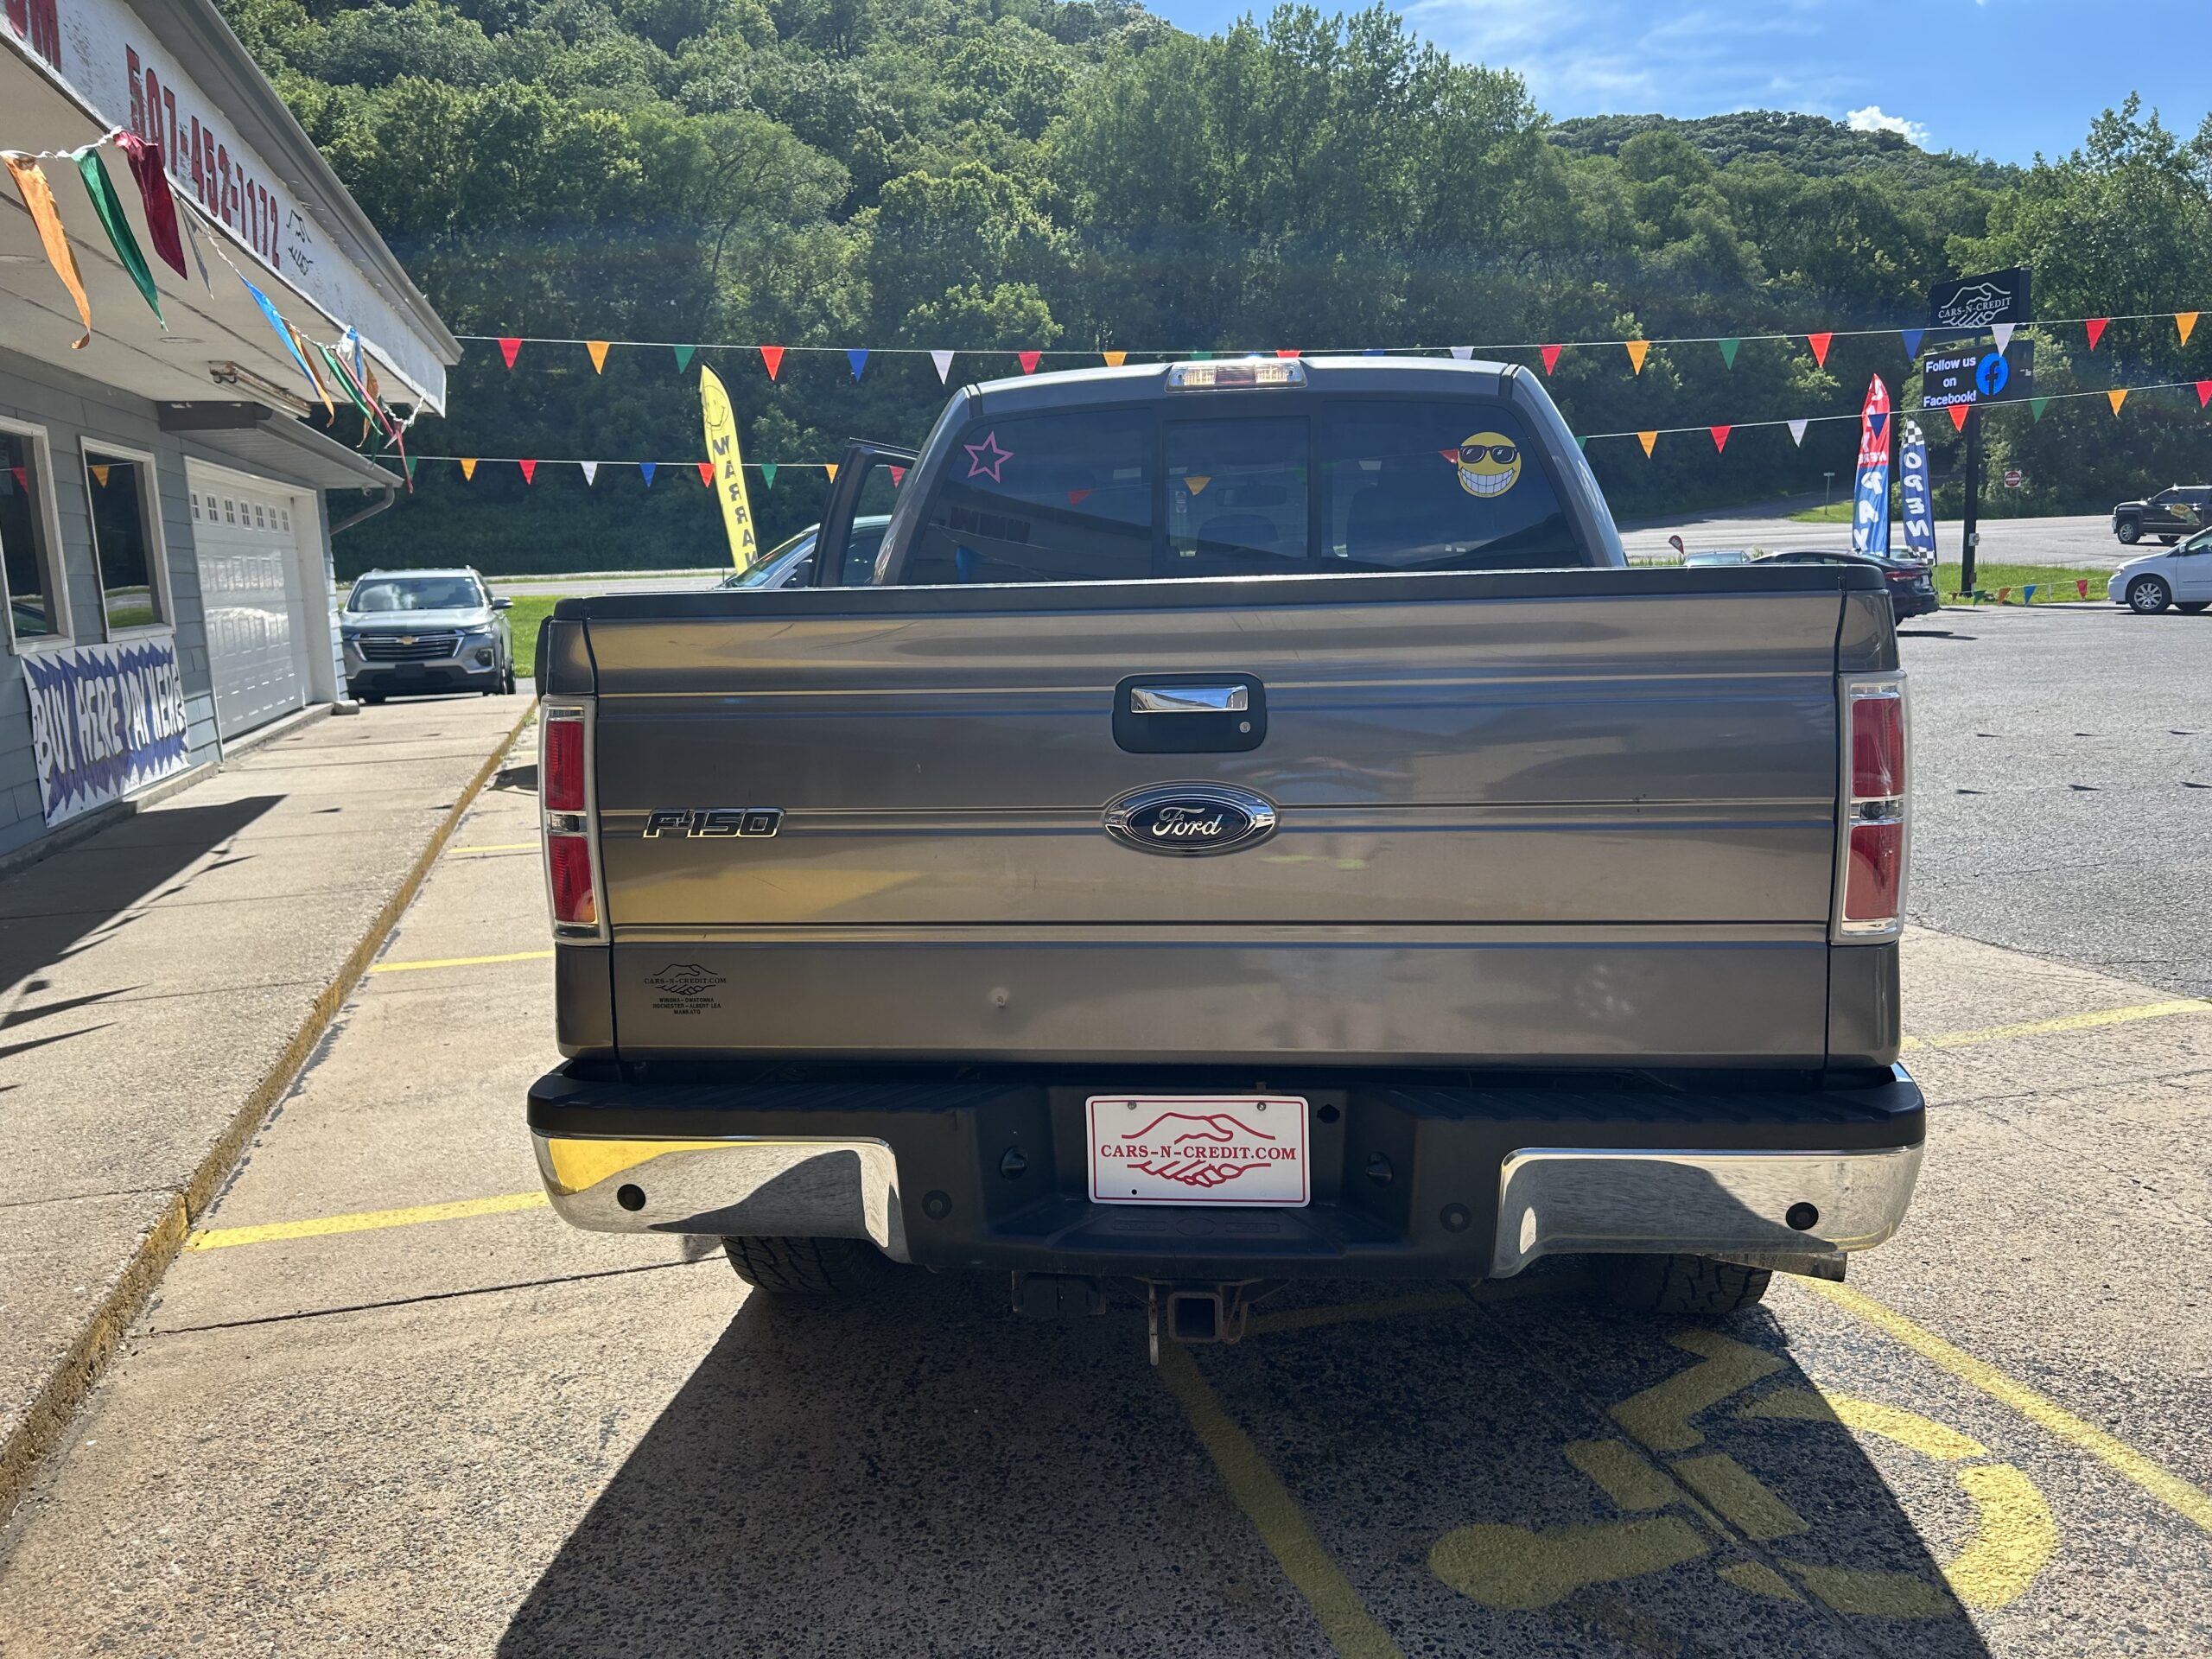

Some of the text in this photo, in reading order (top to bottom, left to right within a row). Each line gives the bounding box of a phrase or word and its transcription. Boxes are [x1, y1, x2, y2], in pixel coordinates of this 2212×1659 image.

[1938, 297, 2012, 319] CARS-N-CREDIT
[1926, 357, 1976, 372] Follow us
[1943, 378, 1956, 387] on
[1923, 391, 1977, 407] Facebook!
[31, 679, 76, 779] BUY
[73, 676, 124, 766] HERE
[119, 665, 150, 752] PAY
[1152, 806, 1224, 836] Ford
[1101, 1145, 1296, 1160] CARS-N-CREDIT.COM
